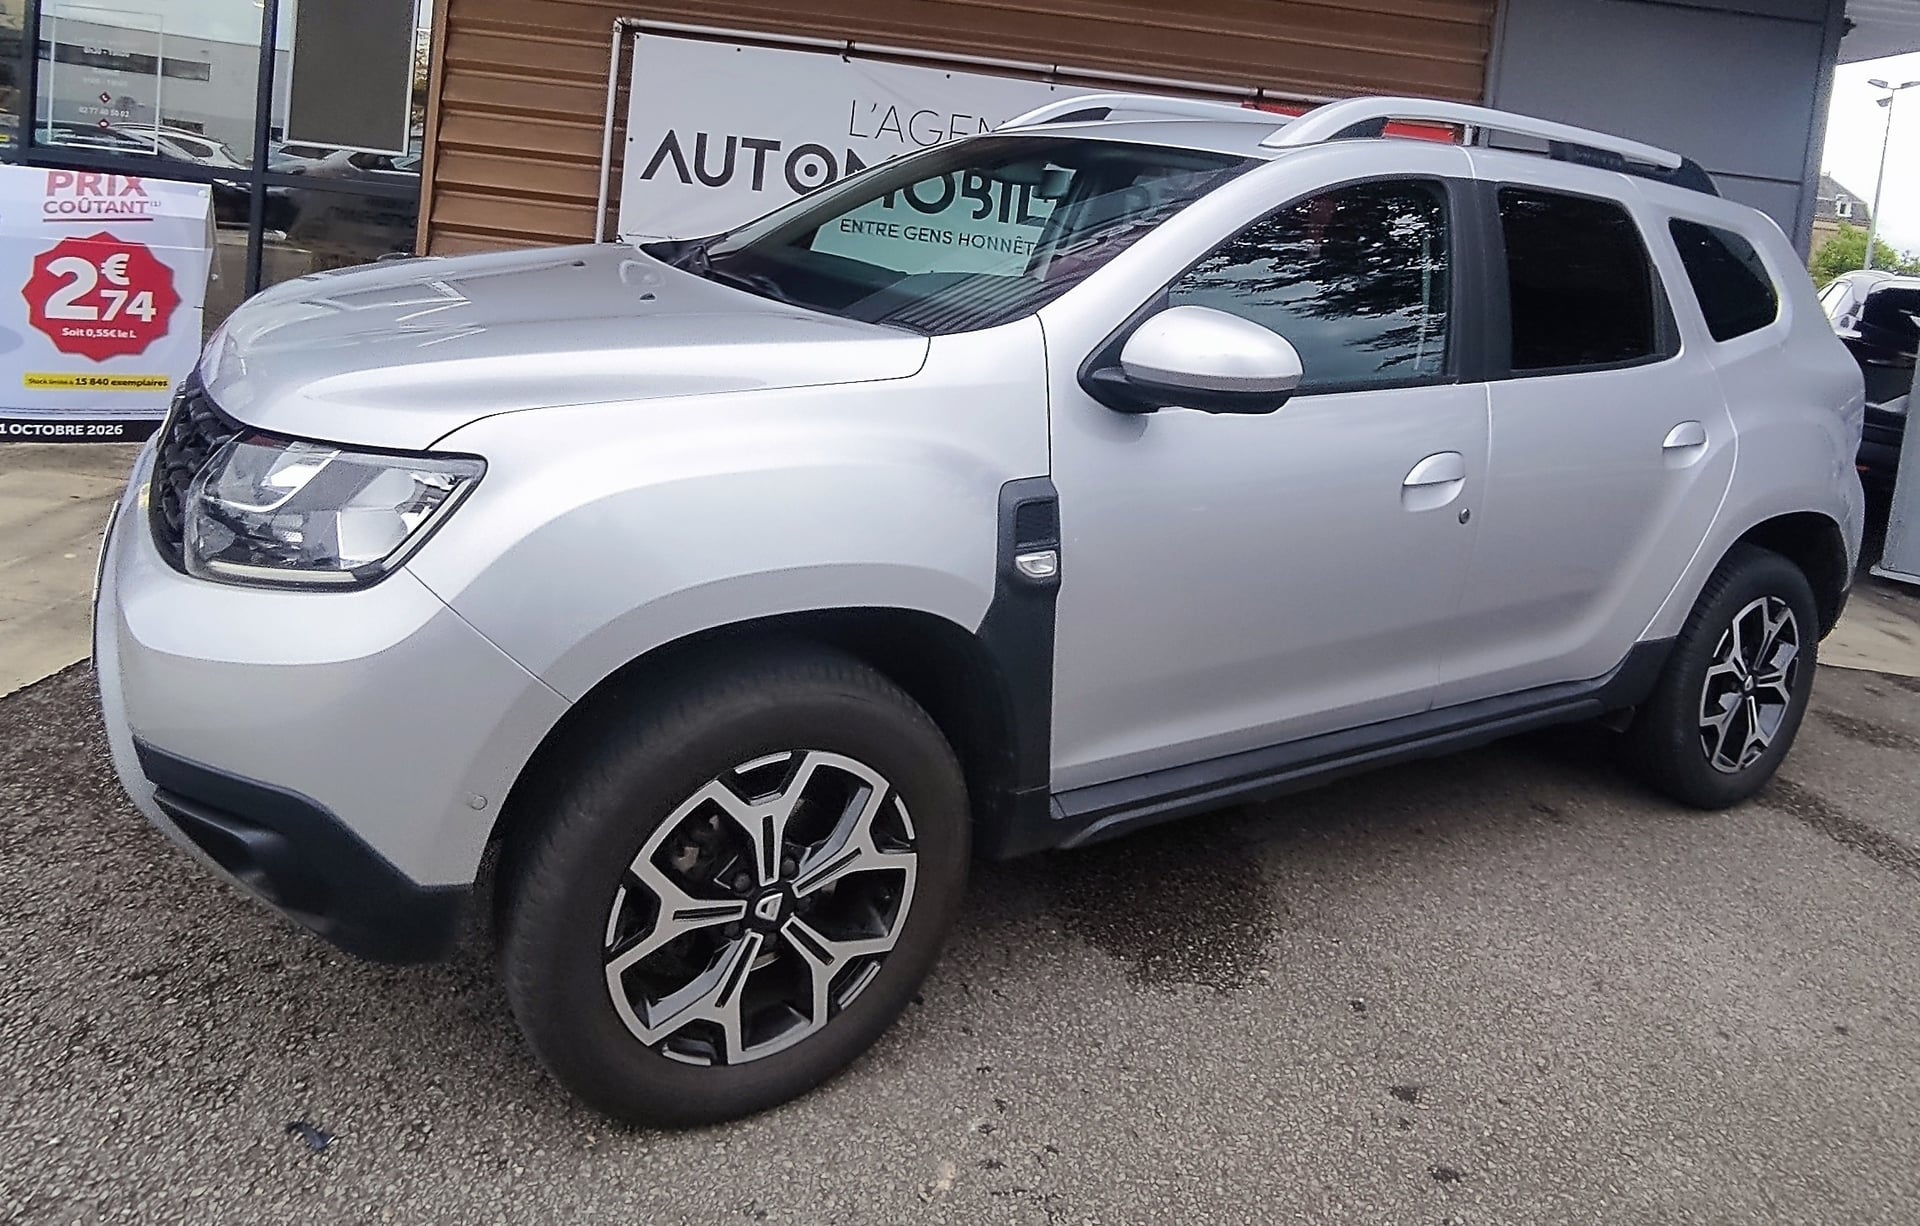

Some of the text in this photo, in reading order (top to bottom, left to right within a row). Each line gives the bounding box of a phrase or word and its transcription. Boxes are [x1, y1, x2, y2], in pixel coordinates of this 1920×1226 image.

[849, 99, 1006, 147] L'AGE
[46, 171, 148, 196] PRIX
[840, 218, 1038, 256] ENTRE GENS HONNÊT
[61, 327, 84, 337] Soit
[117, 329, 128, 338] le
[129, 330, 137, 339] L
[75, 377, 87, 386] 15
[89, 377, 108, 386] 840
[110, 378, 168, 388] exemplaires
[9, 424, 84, 436] OCTOBRE
[86, 424, 124, 436] 2026
